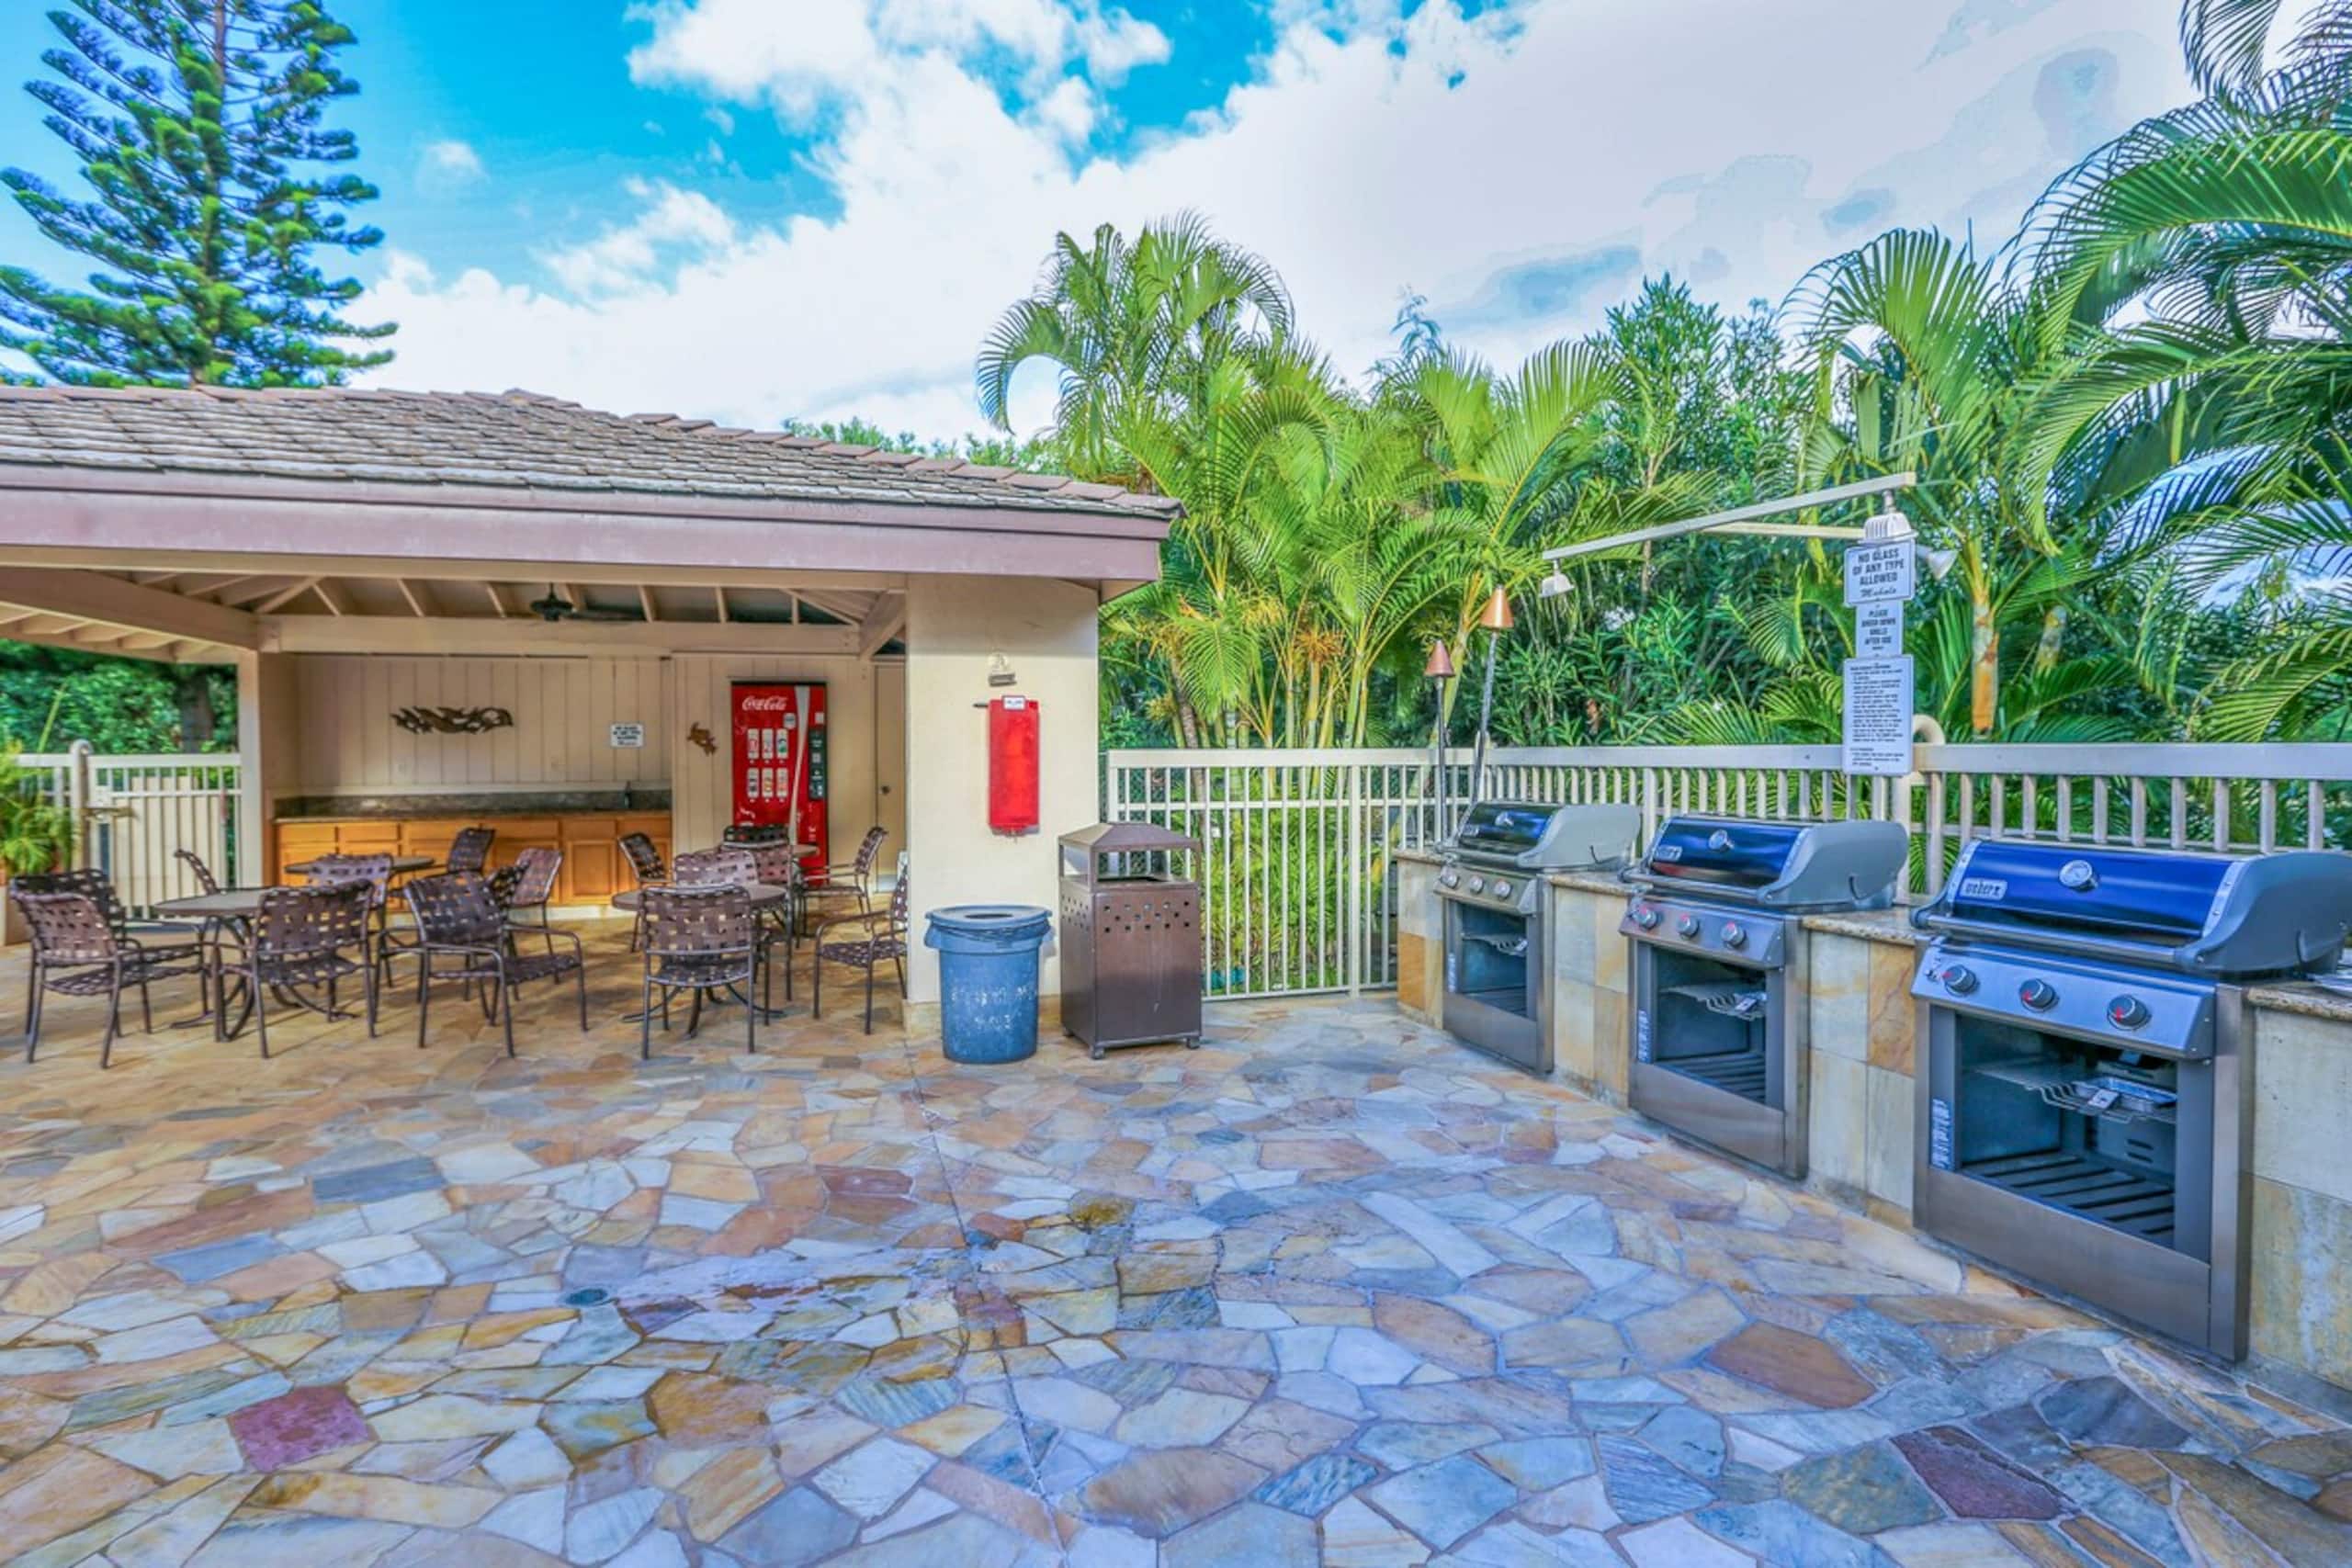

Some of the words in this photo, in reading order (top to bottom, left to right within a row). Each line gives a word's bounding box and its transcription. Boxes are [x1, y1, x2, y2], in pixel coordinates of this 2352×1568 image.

[1858, 552, 1870, 563] NO
[1871, 548, 1899, 561] GLASS
[1852, 565, 1862, 576] OF
[1865, 562, 1882, 573] ANY
[1884, 558, 1904, 570] TYPE
[1860, 572, 1897, 586] ALLOWED
